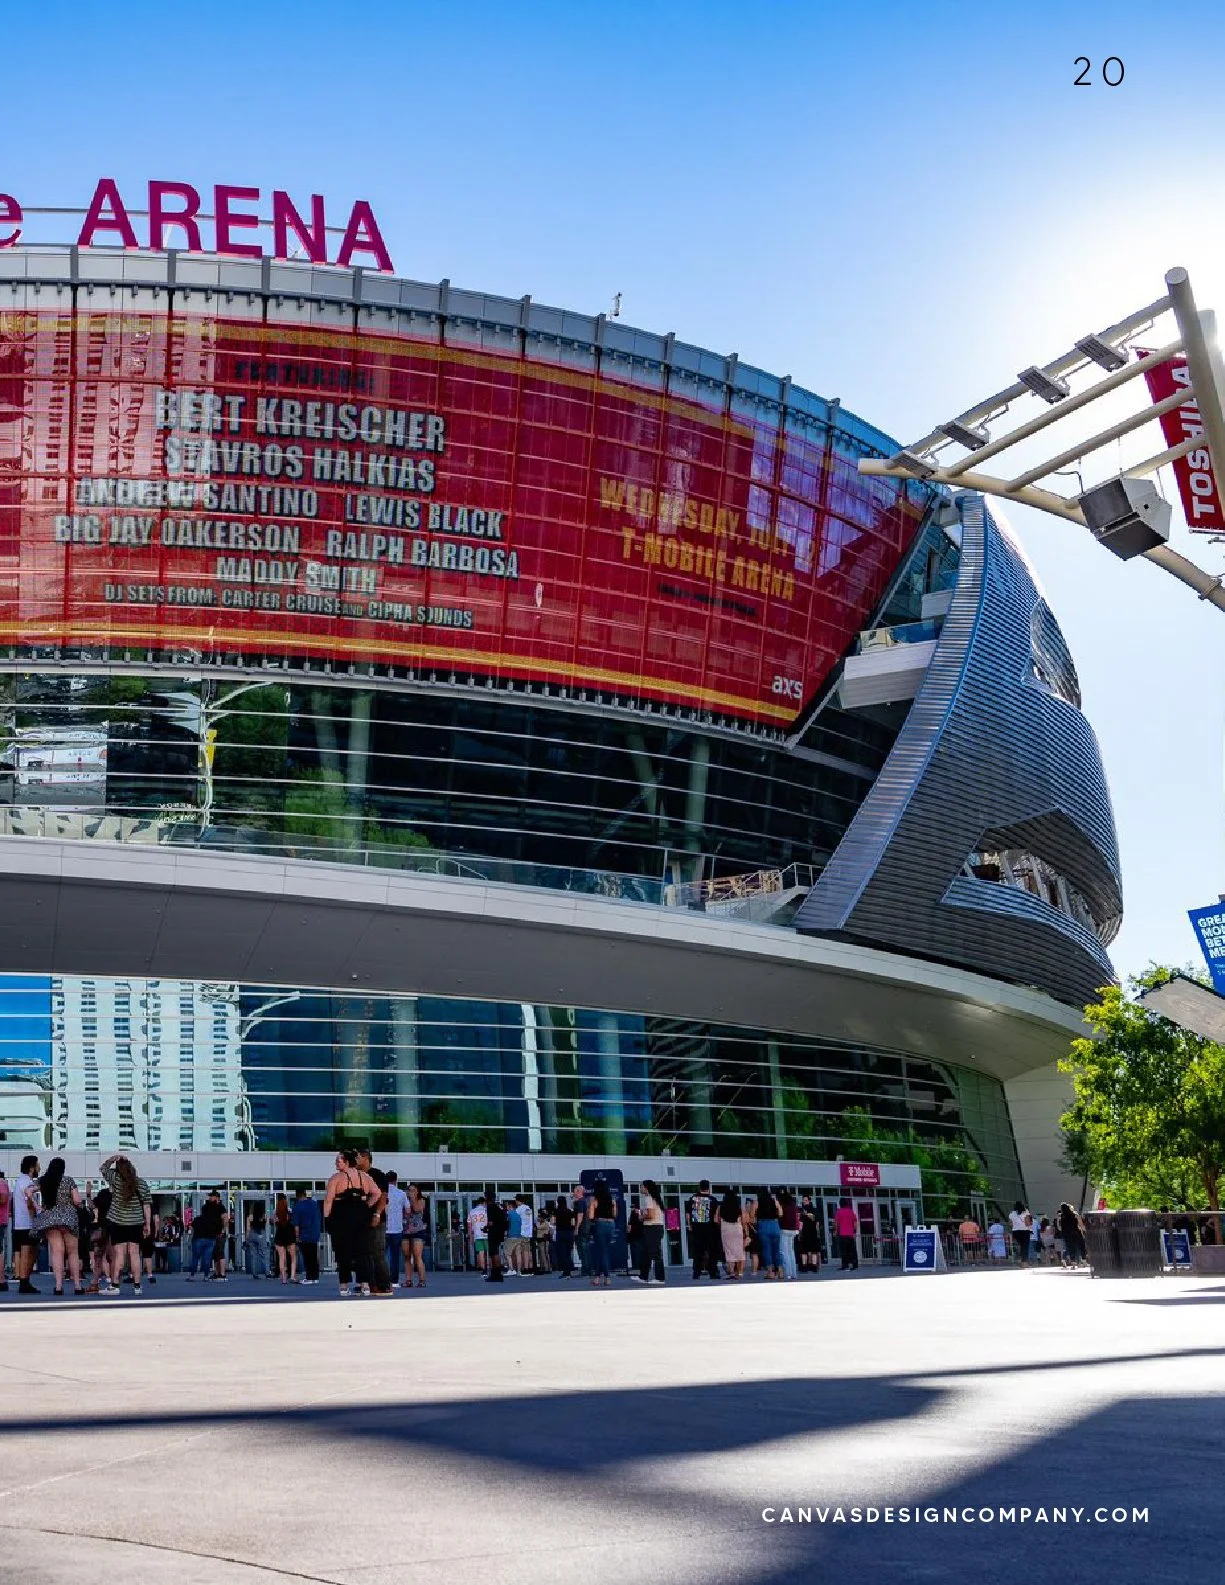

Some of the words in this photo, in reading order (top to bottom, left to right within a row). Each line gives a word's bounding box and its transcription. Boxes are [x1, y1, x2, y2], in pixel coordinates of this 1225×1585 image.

[77, 178, 395, 274] ARENA
[155, 390, 247, 434] BERT
[256, 397, 445, 452] KREISCHER
[166, 435, 303, 477] STAVROS
[314, 447, 435, 492] HALKIAS
[204, 482, 318, 518] SANTINO
[346, 492, 421, 529] LEWIS
[428, 503, 503, 539] BLACK
[54, 515, 103, 543] BIG
[109, 515, 155, 545] JAY
[162, 516, 301, 554] OAKERSON
[327, 529, 405, 563] RALPH
[412, 538, 519, 579] BARBOSA
[216, 556, 299, 586] MADDY
[306, 560, 377, 594] SMITH
[622, 527, 726, 583] T-MOBILE
[731, 556, 796, 602] ARENA
[104, 583, 123, 601] DJ
[127, 584, 165, 602] SETS
[221, 588, 281, 610] CARTER
[286, 593, 342, 614] CRUISE
[368, 601, 412, 621] CIPHA
[771, 675, 804, 699] axs
